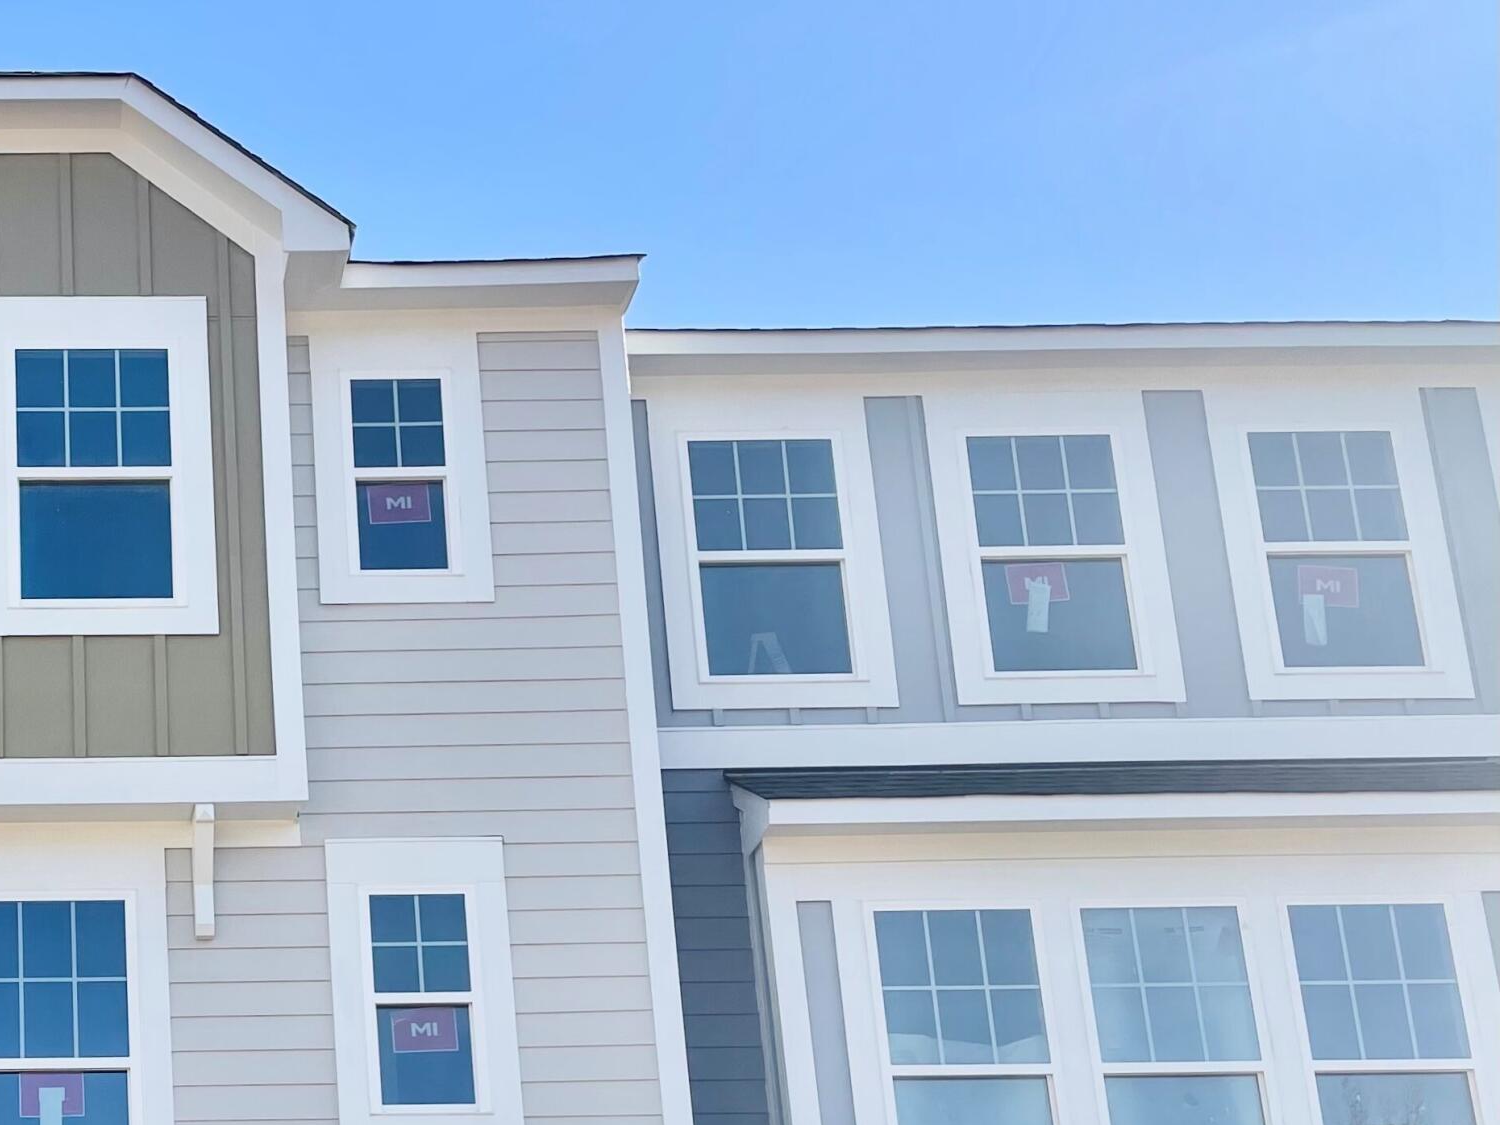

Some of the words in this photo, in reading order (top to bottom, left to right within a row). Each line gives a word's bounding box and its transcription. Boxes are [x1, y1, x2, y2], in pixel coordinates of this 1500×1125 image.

[385, 496, 413, 510] MI
[1316, 578, 1341, 593] MI
[410, 1022, 439, 1037] MI
